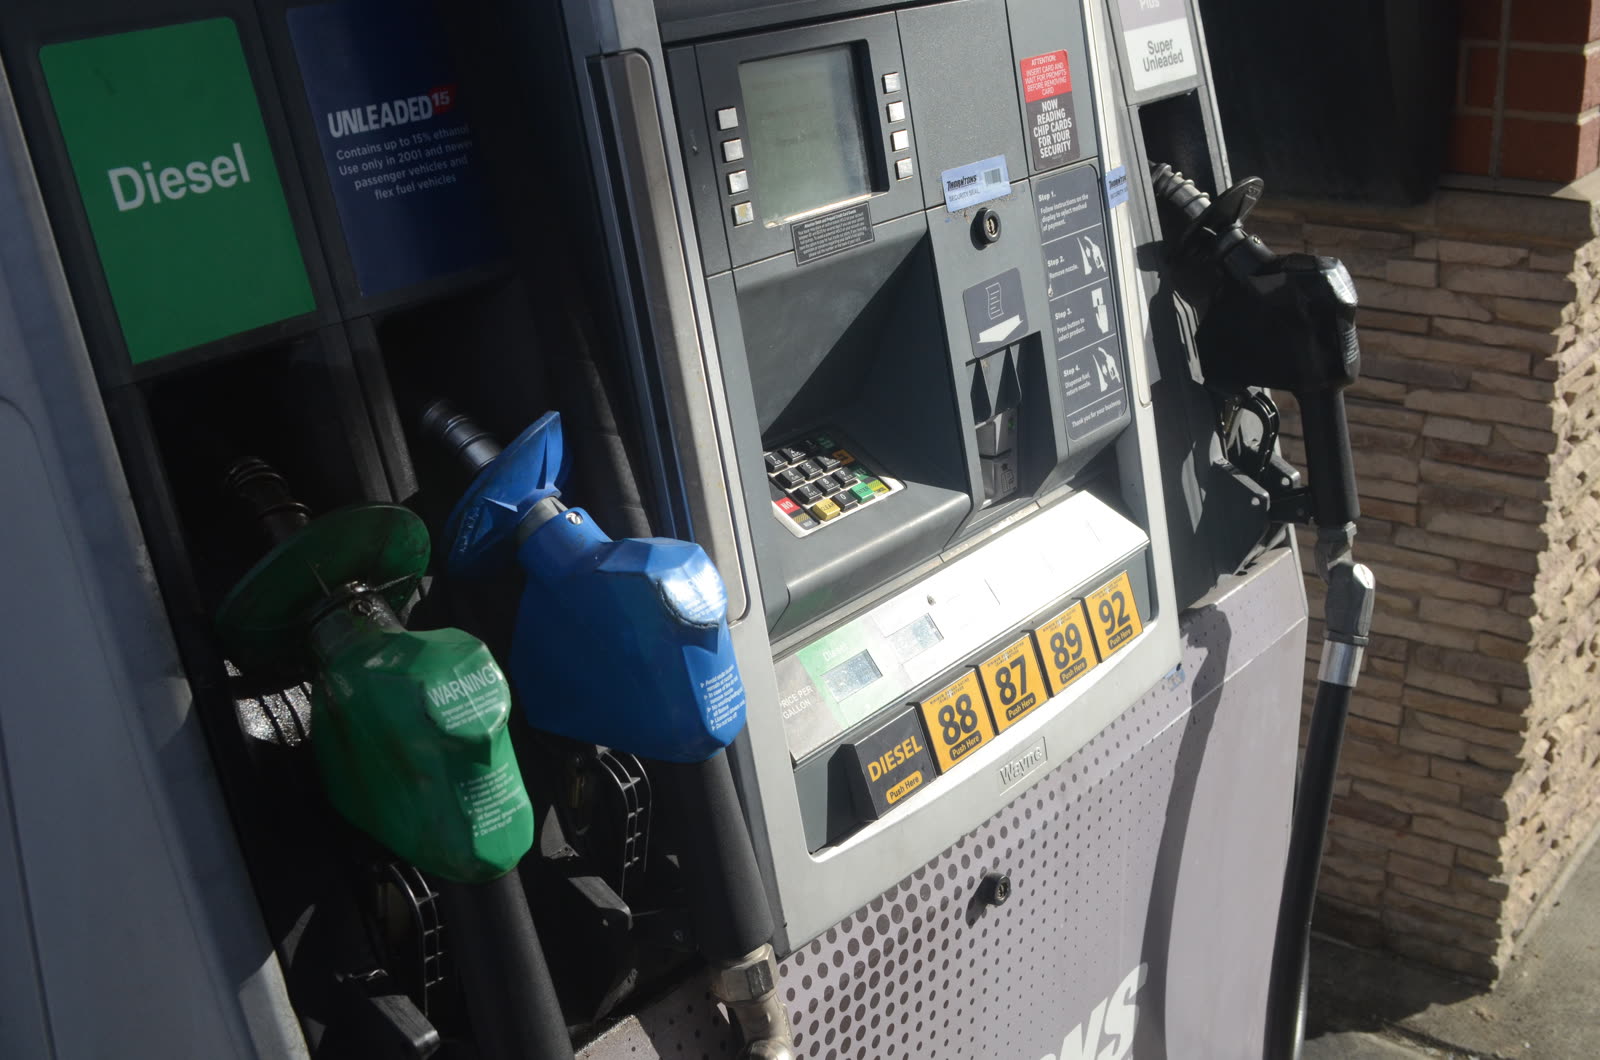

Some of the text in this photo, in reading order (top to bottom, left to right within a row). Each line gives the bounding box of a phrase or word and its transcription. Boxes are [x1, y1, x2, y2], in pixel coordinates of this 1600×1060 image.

[1147, 38, 1173, 56] Super
[1042, 64, 1054, 72] CARD
[1054, 62, 1064, 70] AND
[1142, 48, 1184, 72] Unleaded
[1027, 82, 1044, 92] BEFORE
[1042, 86, 1054, 96] CARD
[328, 91, 450, 138] UNLEADED 15
[1042, 98, 1058, 112] NOW
[1037, 108, 1066, 125] READING
[1034, 118, 1072, 138] CHIP CARDS
[1038, 128, 1070, 148] FOR YOUR
[336, 143, 382, 160] Contains
[384, 140, 397, 150] up
[400, 137, 410, 146] to
[433, 124, 470, 140] ethanol
[1040, 140, 1071, 159] SECURITY
[338, 164, 358, 176] Use
[362, 159, 383, 172] only
[386, 156, 396, 164] in
[398, 150, 422, 162] 2001
[425, 146, 442, 158] and
[107, 143, 251, 212] Diesel
[354, 156, 468, 190] passenger vehicles and
[374, 173, 456, 200] flex fuel vehicles
[1038, 193, 1050, 202] Step
[1048, 258, 1059, 268] Step
[781, 500, 794, 510] NO
[820, 502, 835, 512] CLEAR
[1099, 590, 1130, 636] 92
[1051, 622, 1082, 670] 89
[1109, 628, 1132, 646] Push Here
[995, 654, 1027, 706] 87
[1062, 661, 1086, 680] Push Here
[780, 686, 814, 708] RICE PER
[1008, 697, 1034, 718] Push Here
[782, 699, 811, 720] GALLON
[938, 694, 978, 746] 88
[952, 734, 980, 758] Push Here
[867, 736, 922, 782] DIESEL
[1000, 746, 1042, 785] Wayne
[890, 776, 920, 800] Push Here
[1040, 962, 1148, 1060] NS
